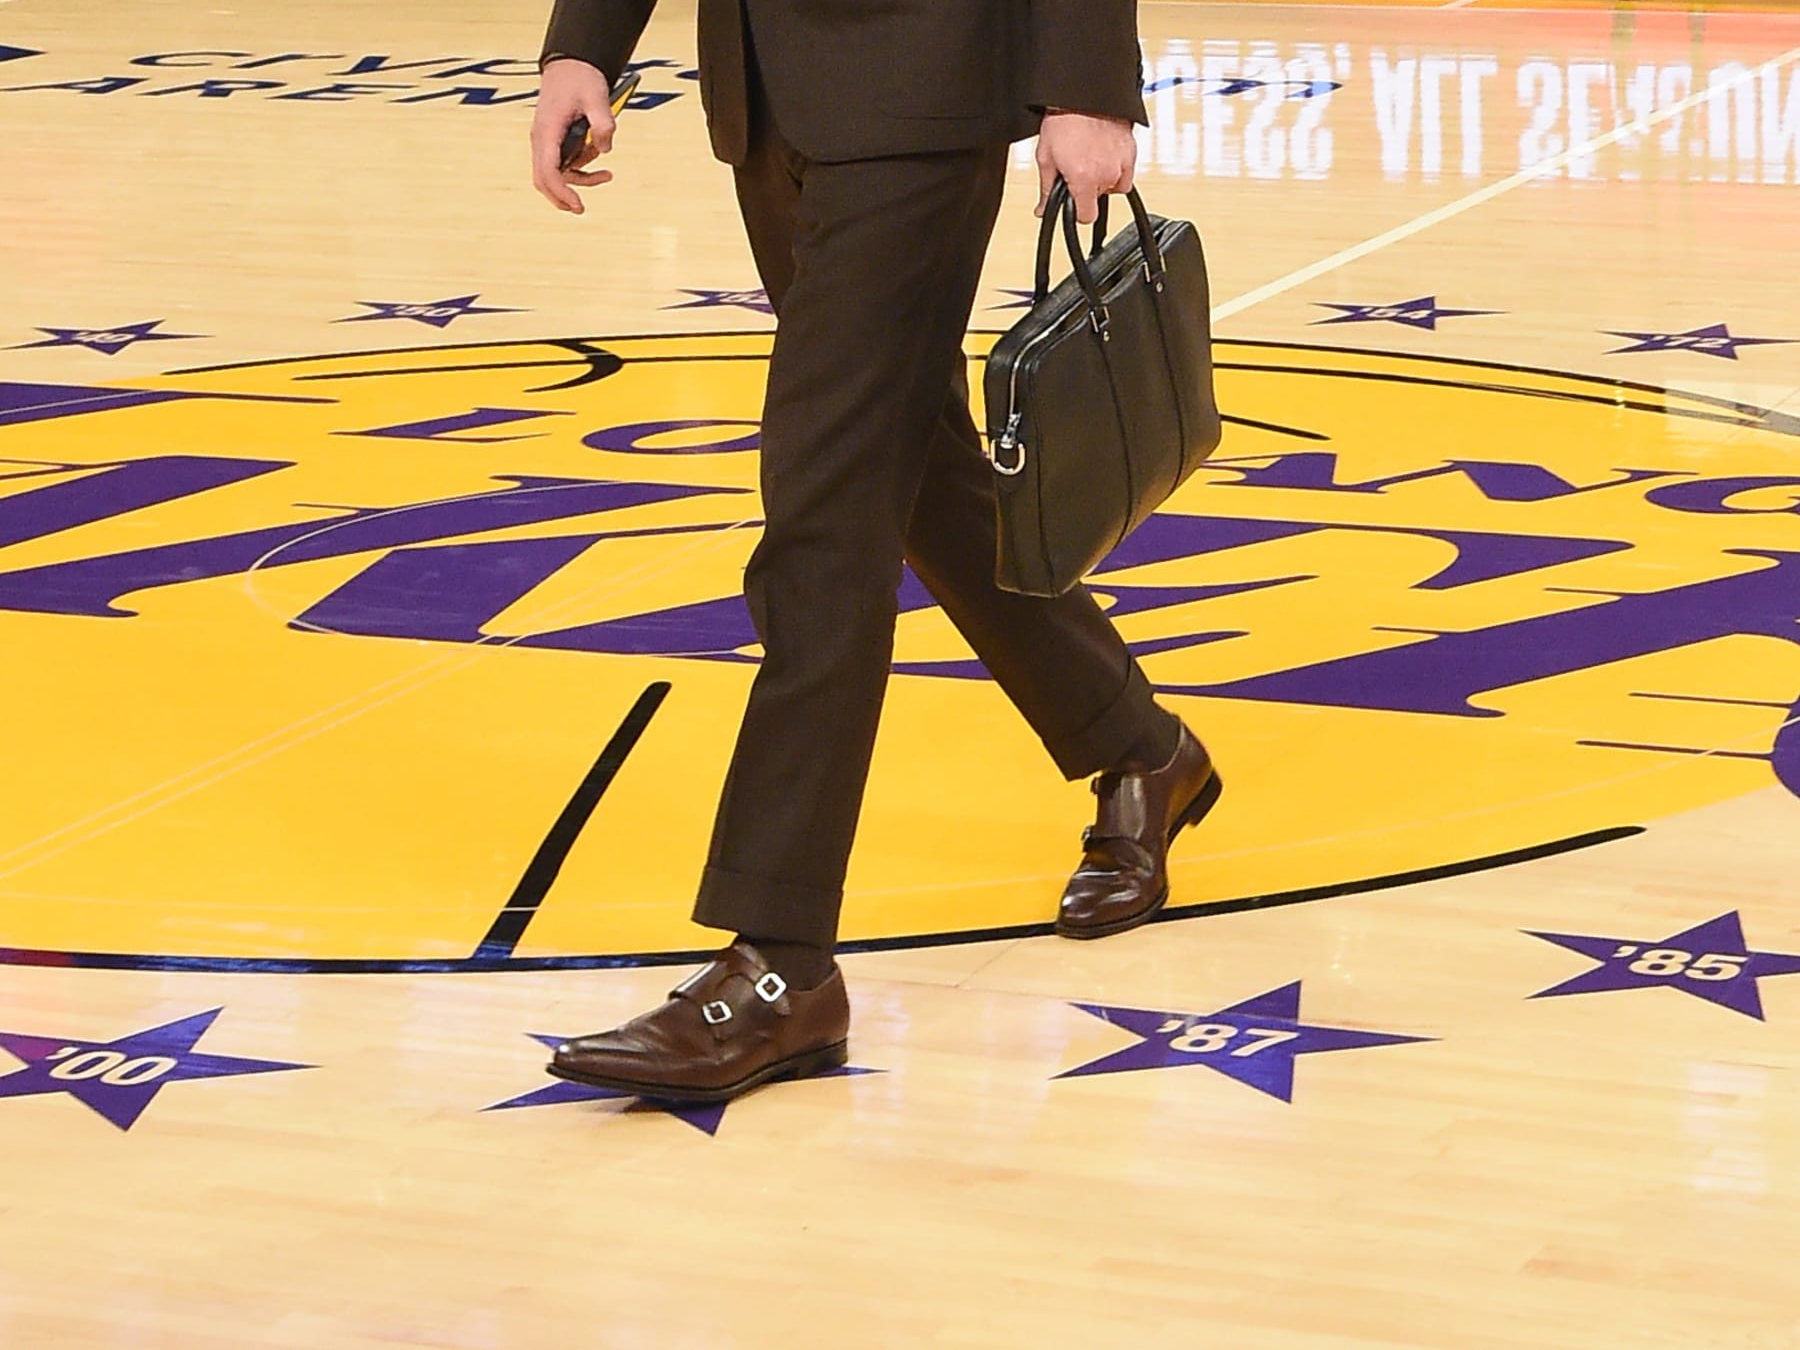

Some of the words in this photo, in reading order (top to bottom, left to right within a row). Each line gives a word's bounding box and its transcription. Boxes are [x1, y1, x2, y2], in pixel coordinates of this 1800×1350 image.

[1357, 306, 1435, 321] '54
[1648, 334, 1731, 349] '72
[1614, 944, 1751, 983] '85
[1155, 1018, 1301, 1059] '87
[45, 1046, 179, 1086] '00
